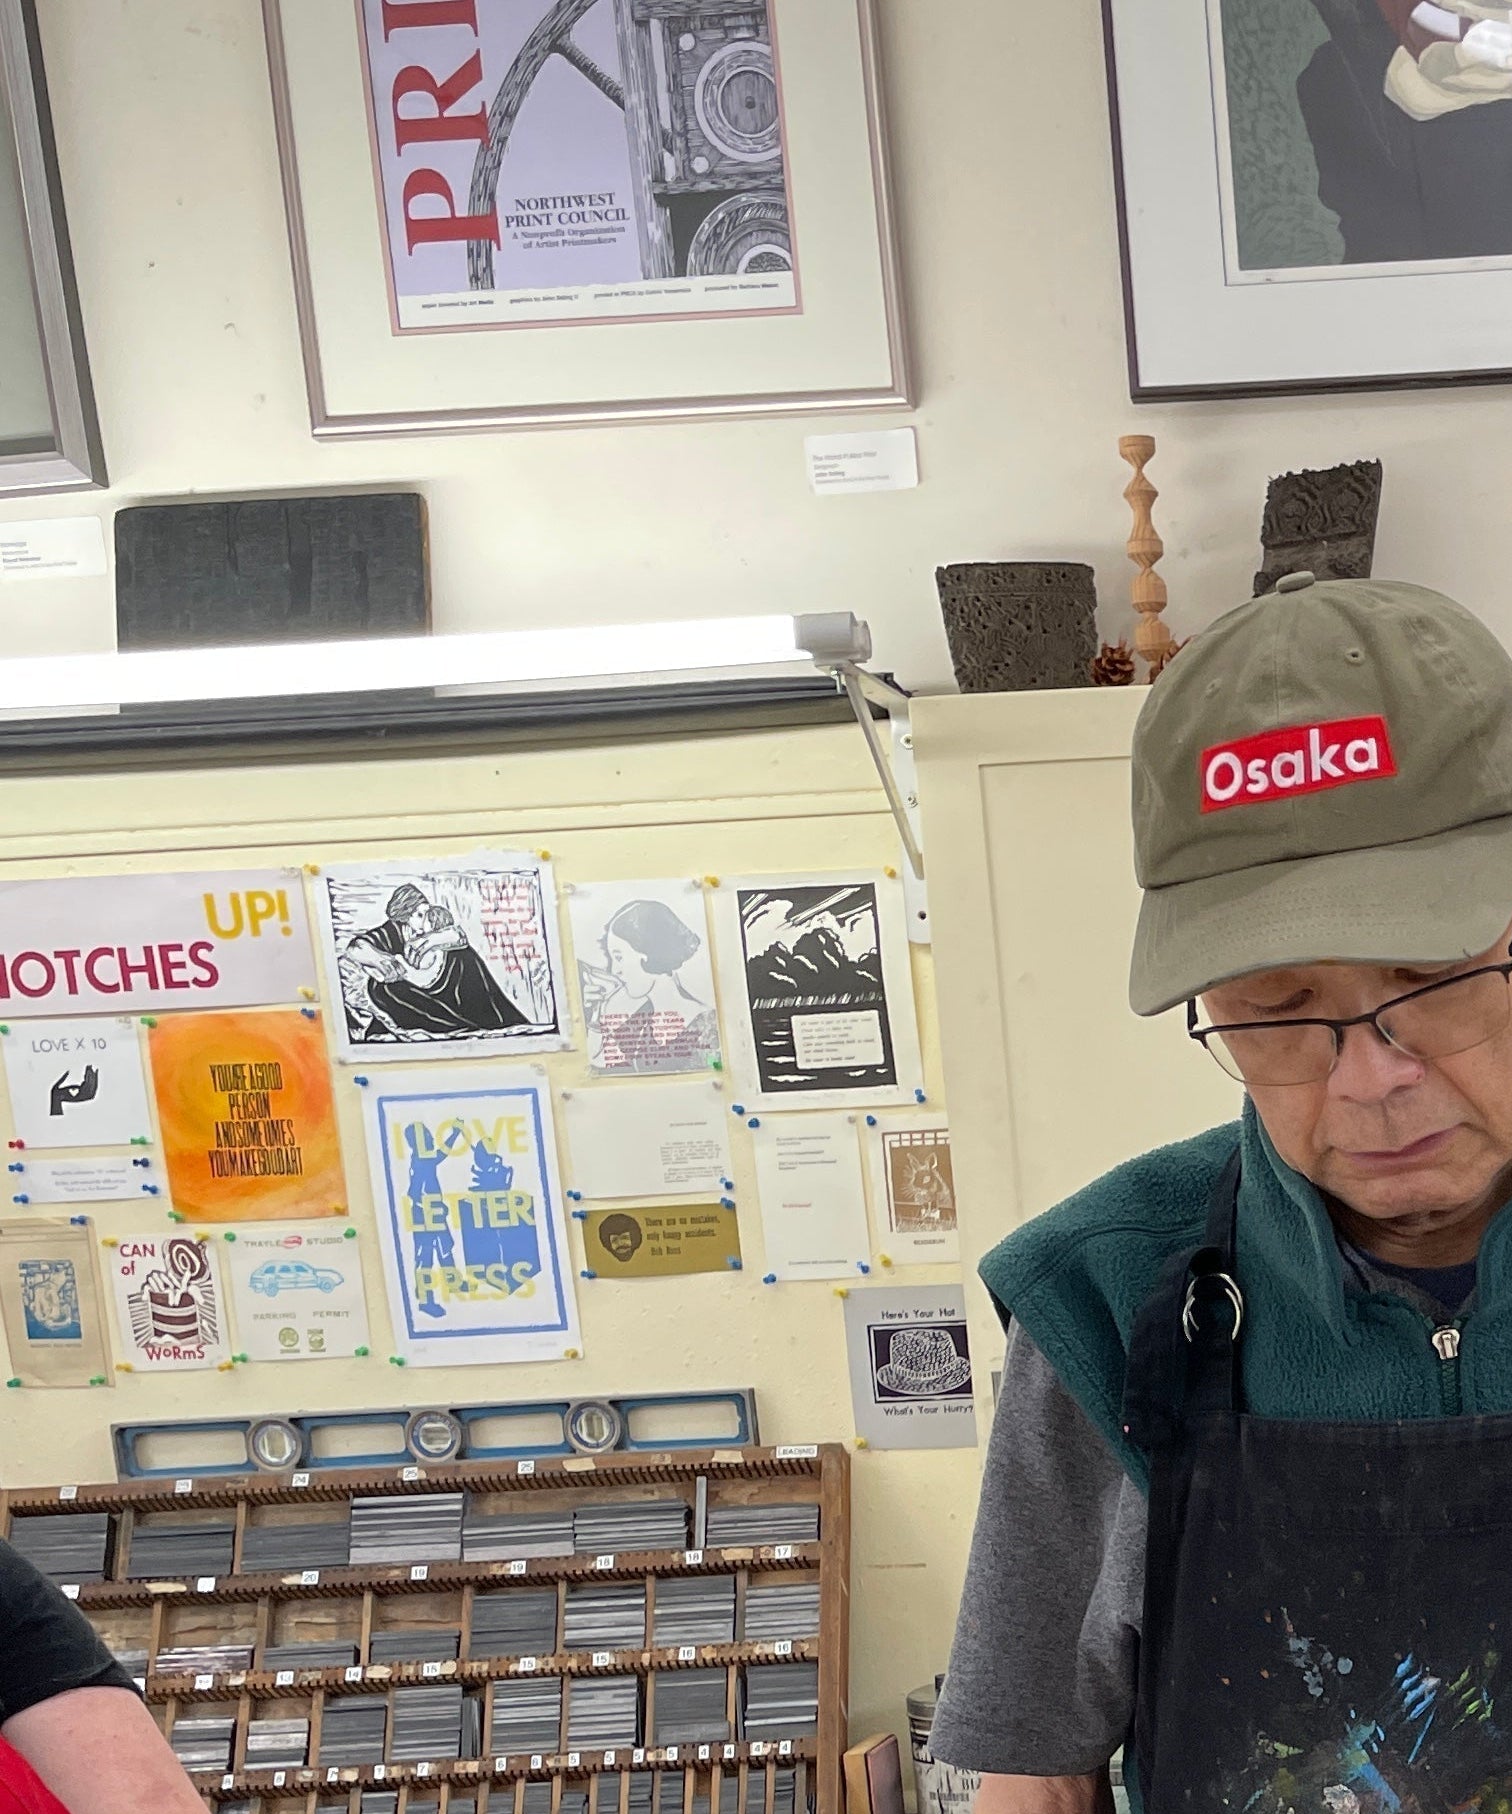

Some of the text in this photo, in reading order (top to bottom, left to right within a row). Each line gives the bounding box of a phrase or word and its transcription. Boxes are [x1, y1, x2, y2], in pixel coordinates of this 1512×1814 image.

[515, 192, 616, 211] NORTHWEST
[505, 208, 630, 228] PRINT COUNCIL
[521, 229, 565, 240] Nonprofit
[568, 226, 626, 238] Organization
[535, 239, 559, 248] Artist
[562, 236, 617, 247] Printmakers
[1206, 728, 1379, 801] Osaka
[203, 890, 292, 940] UP!
[32, 1037, 107, 1053] LOVE X 10
[228, 1092, 271, 1120] PERSON
[393, 1115, 530, 1160] I LOVE
[402, 1190, 537, 1233] LETTER
[645, 1217, 662, 1226] There
[306, 1237, 344, 1246] STUDIO
[120, 1243, 155, 1258] CAN
[121, 1261, 135, 1275] of
[415, 1261, 537, 1305] PRESS
[253, 1310, 350, 1320] PARKING PERMIT
[881, 1308, 956, 1320] Here's Your Hat
[882, 1404, 974, 1416] What's Your Hurry?
[778, 1446, 815, 1457] LEADING
[520, 1462, 533, 1471] 25
[406, 1469, 417, 1478] 25
[294, 1475, 307, 1484] 24
[688, 1552, 700, 1561] 18
[778, 1547, 788, 1557] 17
[513, 1562, 524, 1571] 19
[599, 1557, 610, 1566] 18
[304, 1573, 316, 1582] 20
[414, 1568, 425, 1577] 19
[778, 1643, 789, 1652] 16
[681, 1649, 693, 1658] 16
[522, 1659, 534, 1669] 15
[595, 1654, 607, 1664] 15
[700, 1748, 708, 1757] 4
[726, 1747, 733, 1756] 4
[754, 1743, 762, 1752] 4
[782, 1743, 789, 1752] 4
[606, 1753, 613, 1763] 5
[636, 1750, 643, 1760] 5
[668, 1748, 675, 1758] 5
[498, 1759, 505, 1769] 6
[571, 1754, 578, 1765] 5
[419, 1764, 426, 1774] 7
